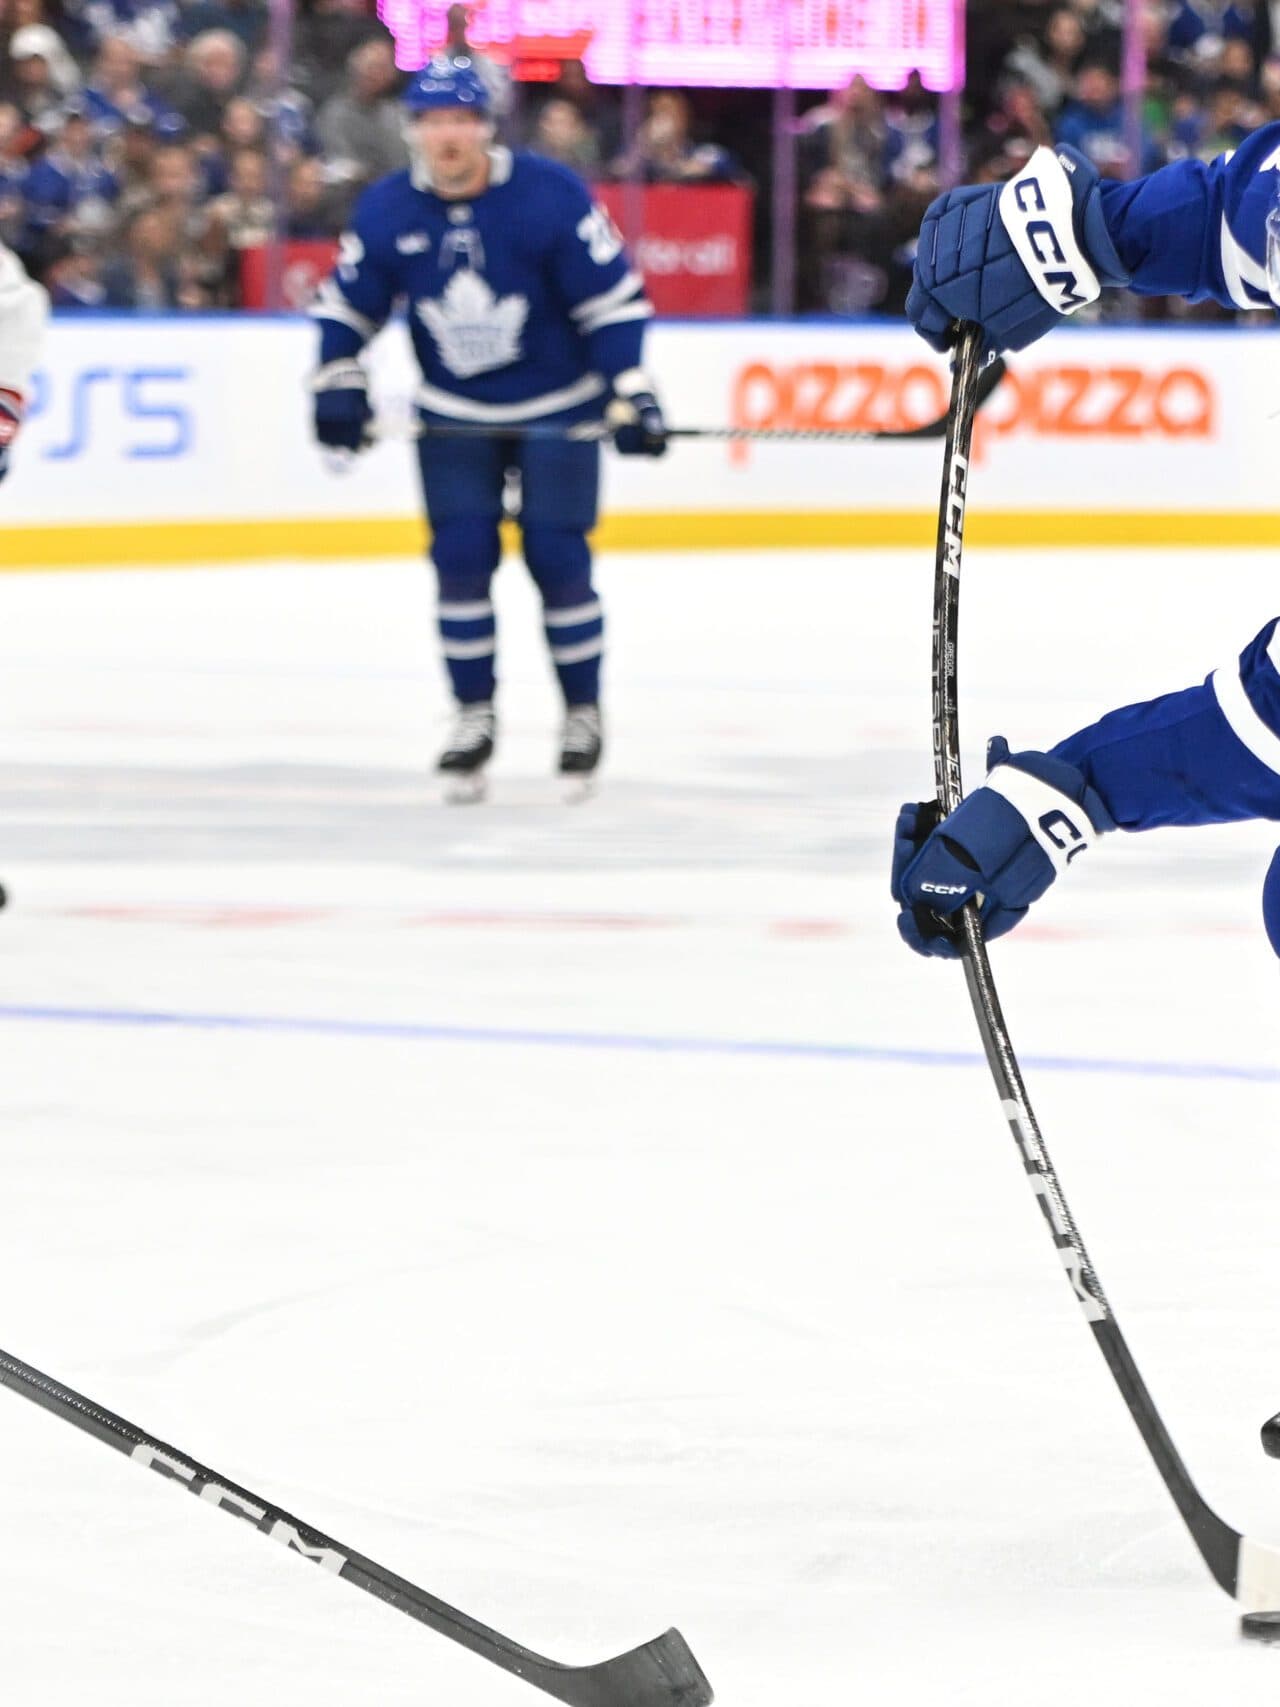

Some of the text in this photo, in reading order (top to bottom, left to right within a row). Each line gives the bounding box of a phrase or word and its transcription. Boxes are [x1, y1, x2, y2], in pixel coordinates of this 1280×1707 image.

[1014, 176, 1088, 311] CCM
[731, 361, 950, 467] pizza
[942, 453, 969, 580] CCM
[920, 882, 967, 895] CCM
[1000, 1098, 1107, 1323] CCM
[131, 1444, 348, 1577] CCM
